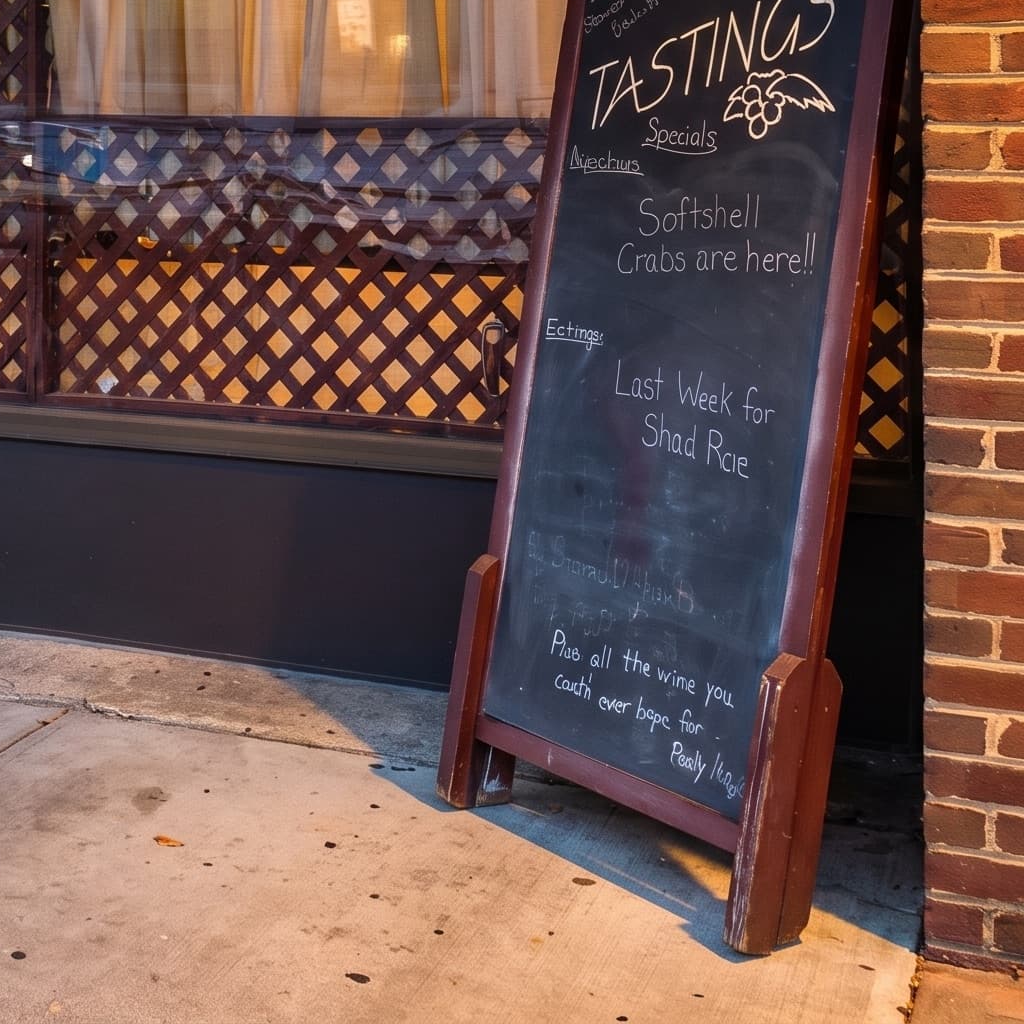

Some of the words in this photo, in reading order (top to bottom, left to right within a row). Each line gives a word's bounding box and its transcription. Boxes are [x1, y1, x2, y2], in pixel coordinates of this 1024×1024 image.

[641, 116, 719, 152] Specials
[638, 193, 760, 237] Softshell
[617, 242, 686, 275] Crabs
[695, 249, 738, 272] are
[614, 359, 665, 401] Last
[677, 370, 734, 418] Week
[742, 386, 776, 425] for
[641, 412, 697, 461] Shad
[590, 644, 613, 670] all
[623, 648, 652, 678] the
[705, 682, 735, 709] you
